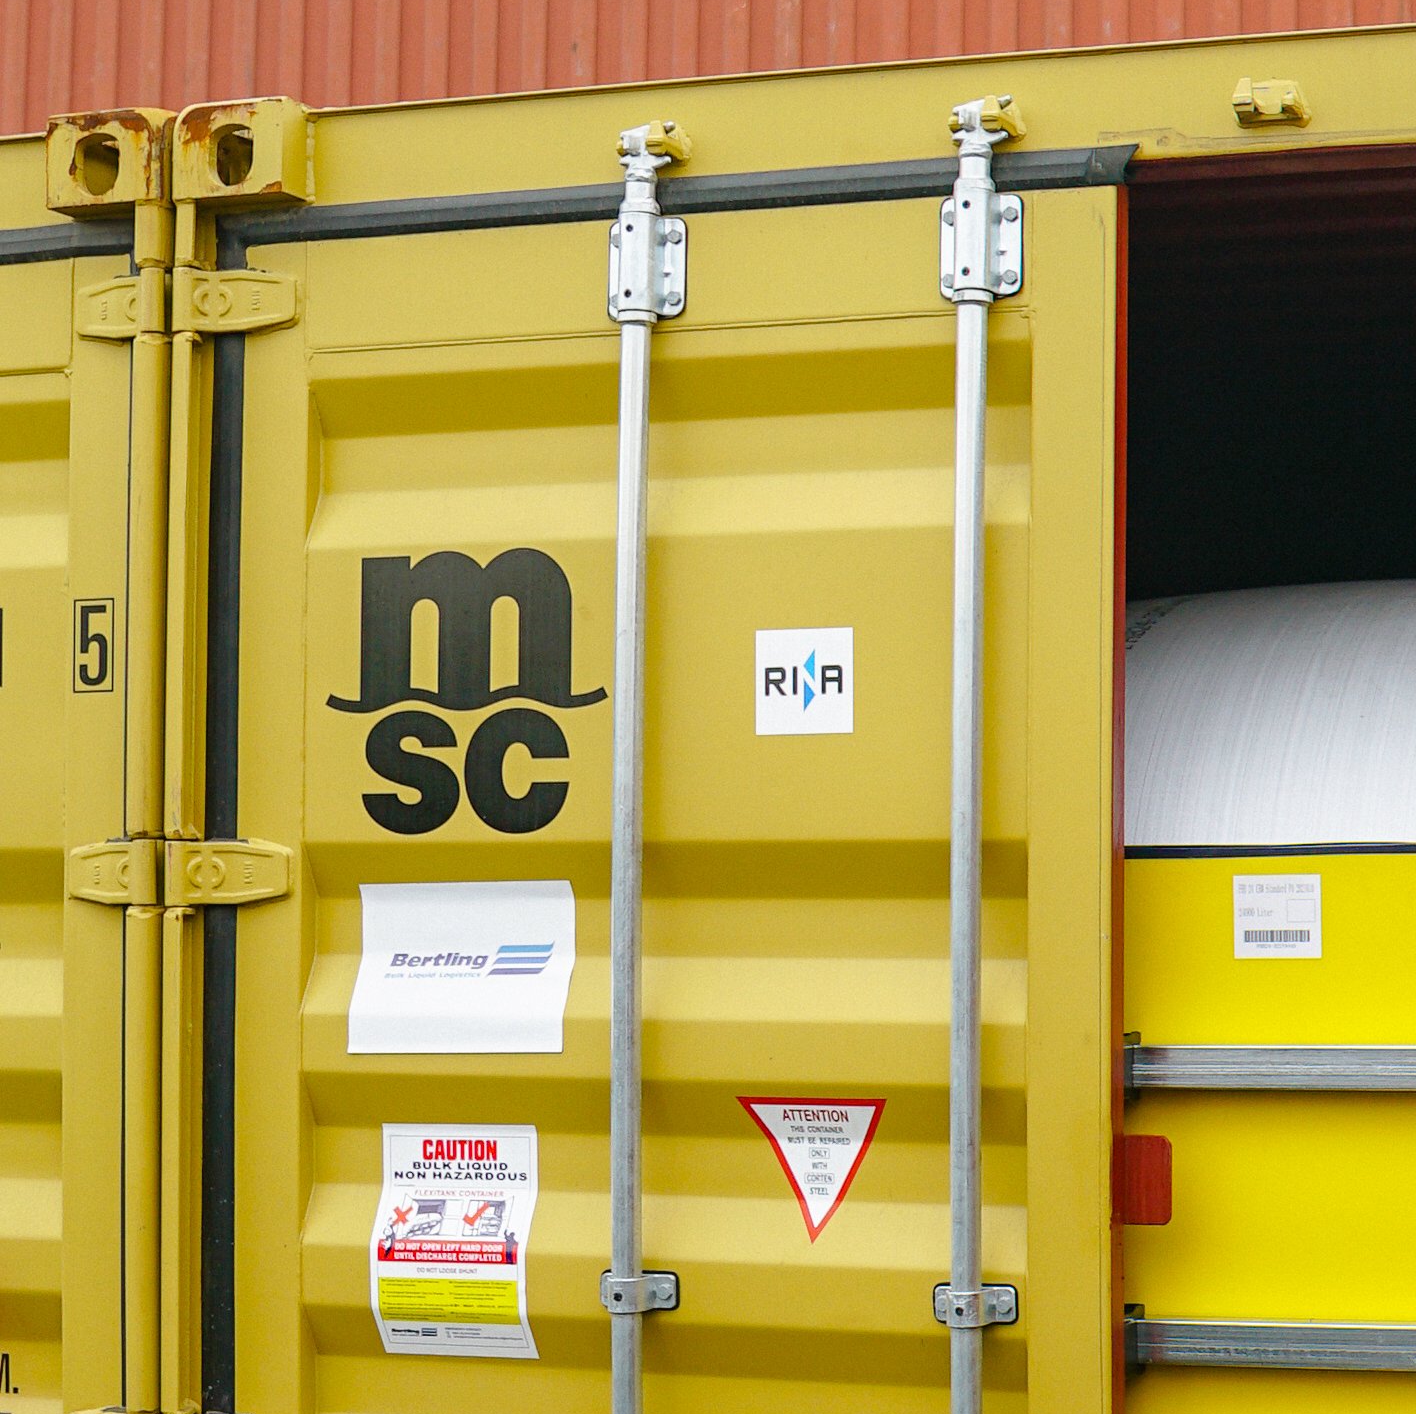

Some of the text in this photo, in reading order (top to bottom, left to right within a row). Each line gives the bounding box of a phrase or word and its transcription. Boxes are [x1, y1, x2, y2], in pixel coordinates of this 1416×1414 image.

[79, 604, 108, 686] 5
[764, 650, 843, 712] RINA
[390, 952, 489, 969] Bertling
[783, 1108, 849, 1122] ATTENTION
[820, 1137, 851, 1145] REPAIRED
[422, 1139, 497, 1161] CAUTION
[412, 1161, 508, 1171] BULK LIQUID
[394, 1171, 528, 1180] NON HAZARDOUS
[394, 1242, 503, 1252] DO NOT OPEN LEFT HAND DOOR
[394, 1252, 502, 1262] UNTIL DISCHARGE COMPLETED
